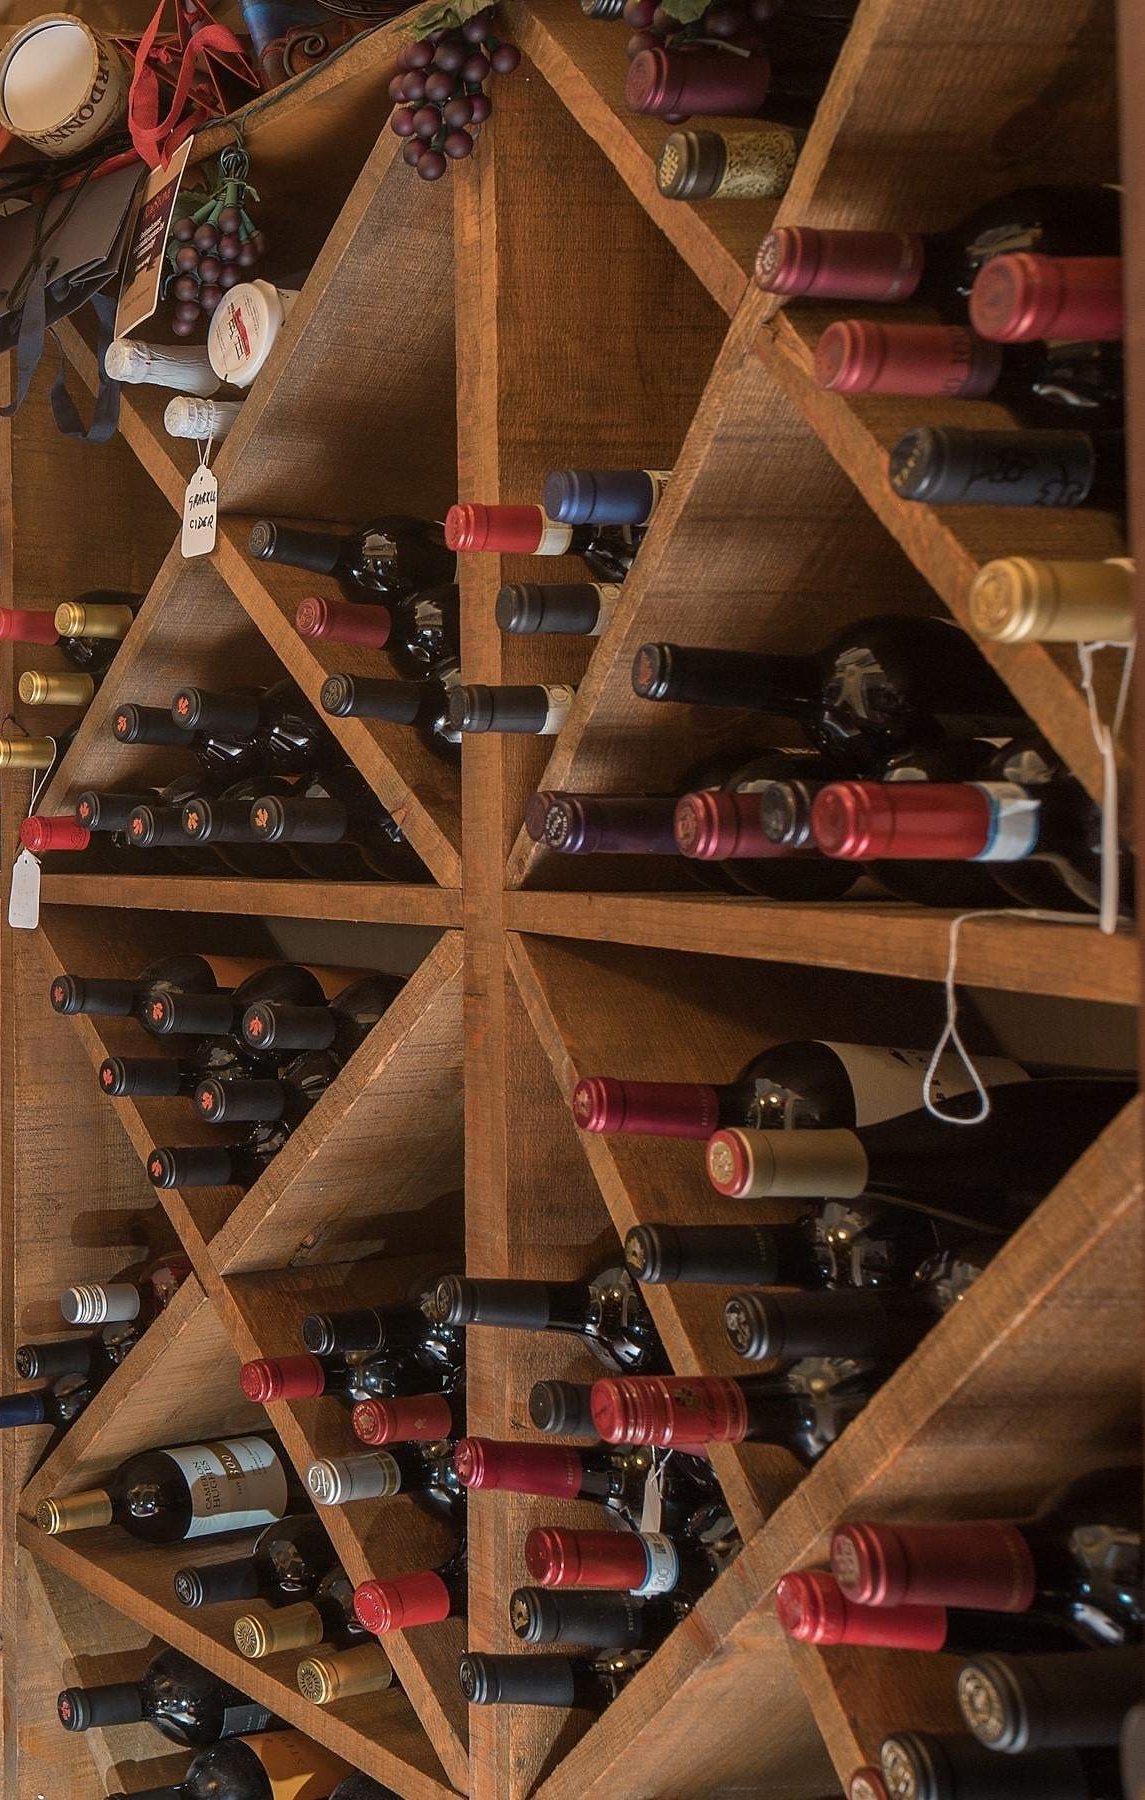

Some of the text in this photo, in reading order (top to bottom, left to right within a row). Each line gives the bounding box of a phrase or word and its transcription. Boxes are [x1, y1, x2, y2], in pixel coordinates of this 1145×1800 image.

[189, 514, 214, 530] CIDER
[192, 1461, 213, 1510] CAMERON
[200, 1459, 221, 1508] HUGHES
